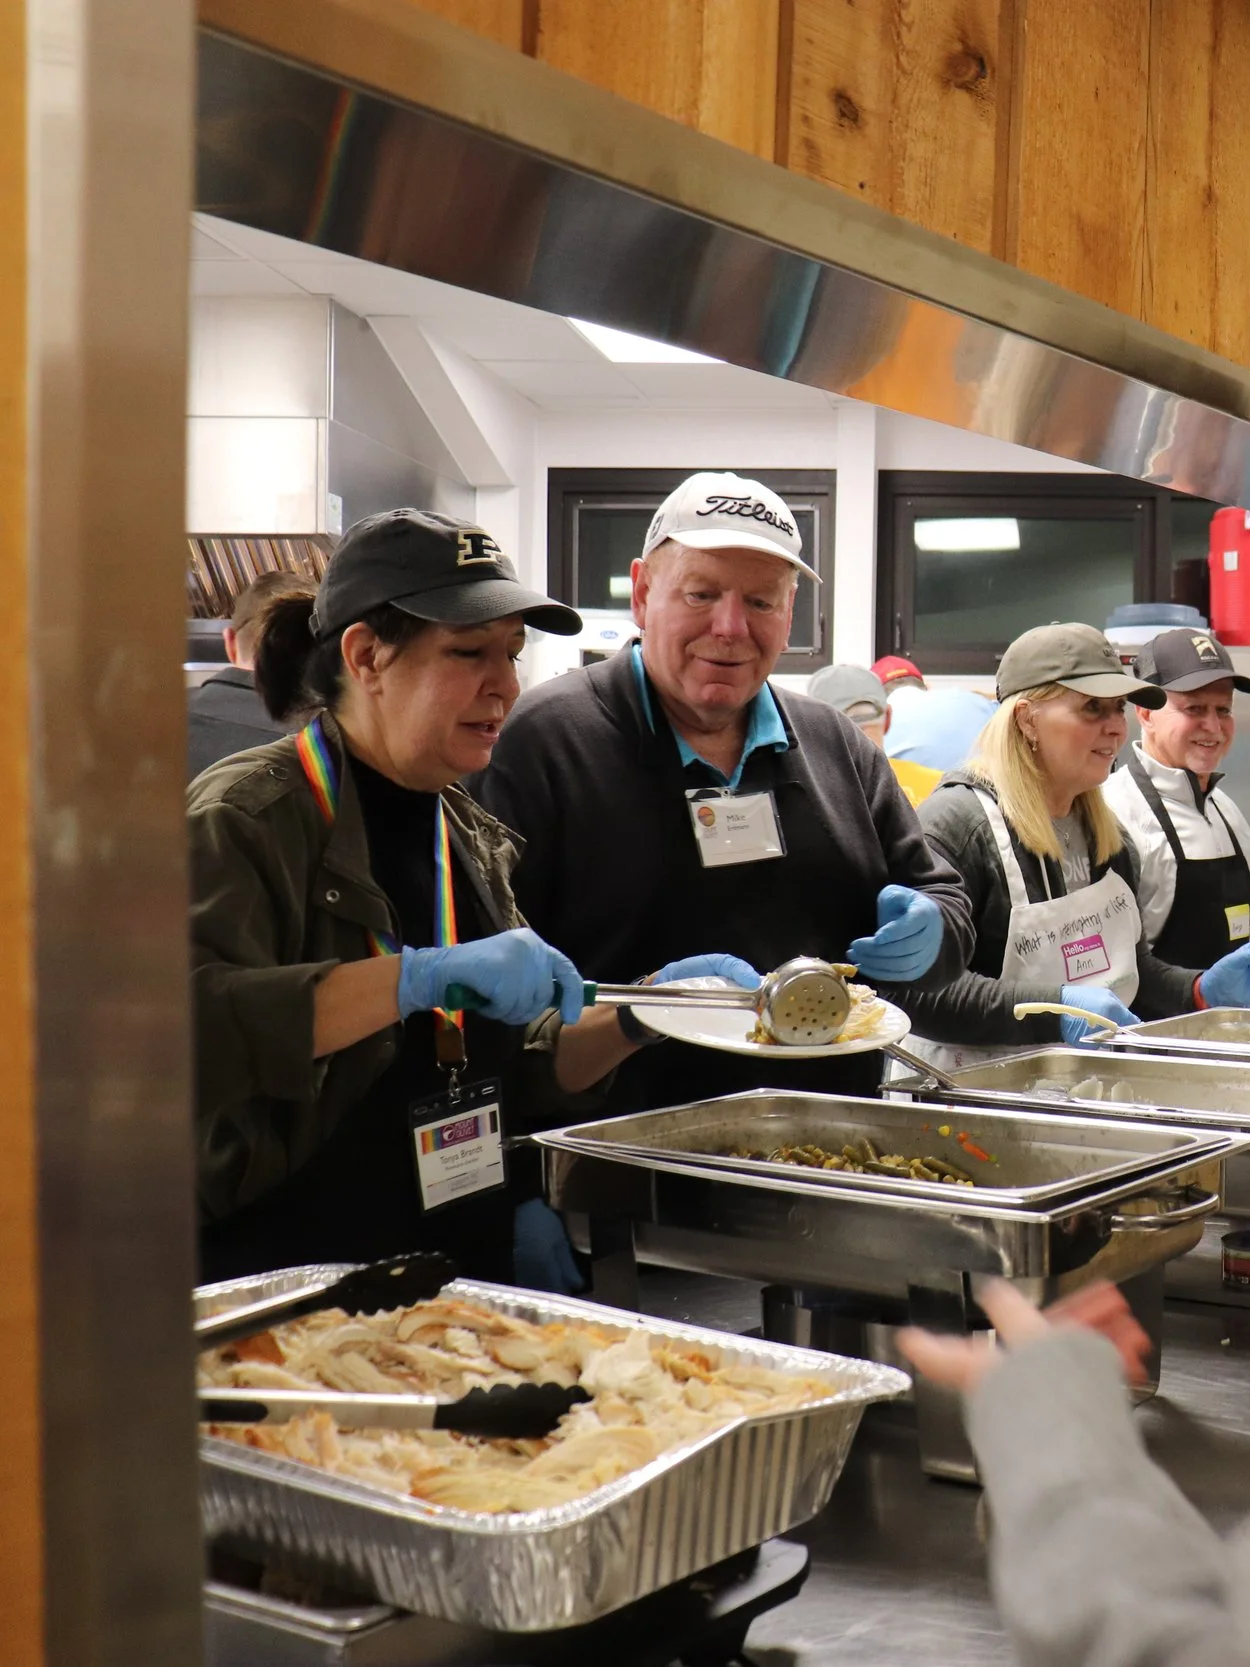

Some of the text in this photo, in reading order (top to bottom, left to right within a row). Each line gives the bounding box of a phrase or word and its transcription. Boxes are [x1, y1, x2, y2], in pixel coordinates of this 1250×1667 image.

[696, 495, 794, 536] Titleist
[726, 814, 747, 823] Mike
[1014, 931, 1042, 956] What
[1047, 931, 1056, 944] is
[1063, 943, 1084, 957] Hello
[1076, 959, 1095, 973] Ann
